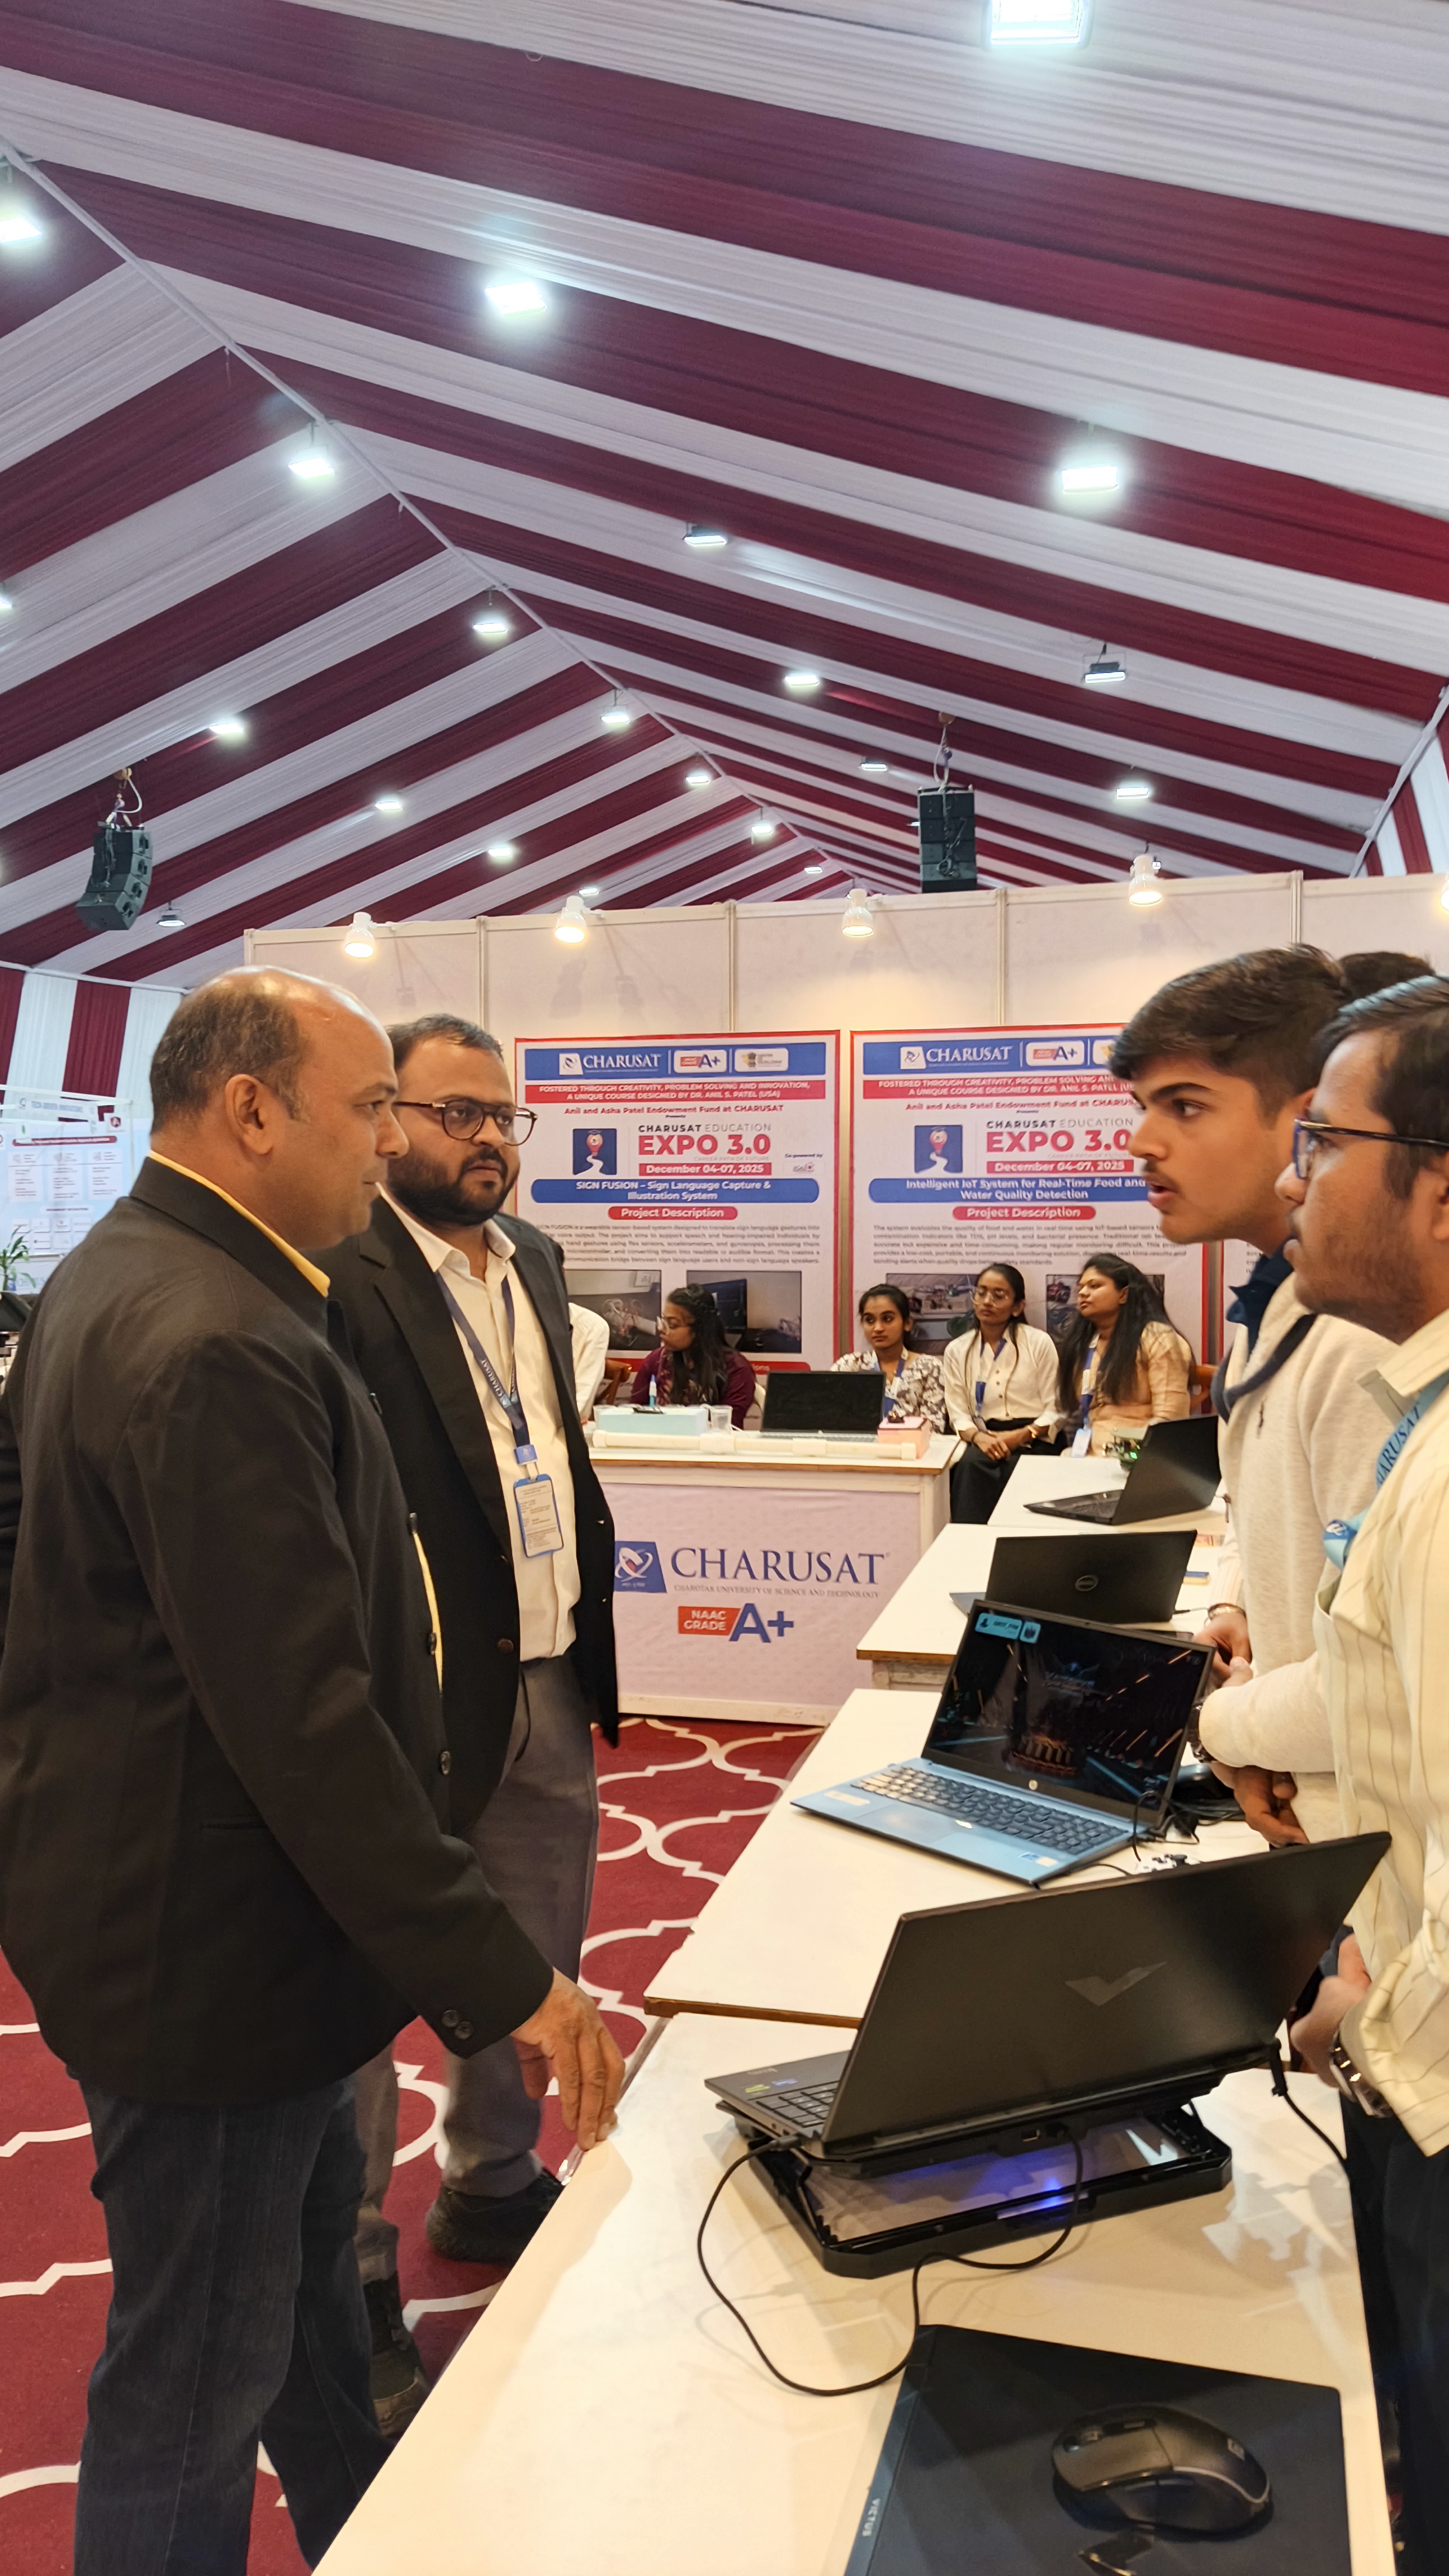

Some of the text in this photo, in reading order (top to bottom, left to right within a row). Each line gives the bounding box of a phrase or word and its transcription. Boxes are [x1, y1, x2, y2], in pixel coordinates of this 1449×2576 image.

[926, 1046, 1012, 1063] CHARUSAT
[1053, 1046, 1077, 1061] A+
[583, 1054, 661, 1068] CHARUSAT
[698, 1053, 721, 1068] A+
[964, 1078, 1014, 1087] CREATIVITY,
[759, 1090, 781, 1098] (USA)
[638, 1124, 771, 1133] CHARUSAT EDUCATION
[987, 1118, 1133, 1129] CHARUSAT EDUCATION
[638, 1134, 771, 1155] EXPO 3.0
[987, 1129, 1131, 1153] EXPO 3.0
[646, 1164, 764, 1175] December 04-07, 2025
[995, 1161, 1125, 1173] December 04-07, 2025
[576, 1181, 600, 1190] SIGN
[602, 1181, 638, 1190] FUSION
[647, 1181, 670, 1190] Sign
[671, 1181, 720, 1191] Language
[722, 1181, 761, 1190] Capture
[906, 1178, 1145, 1191] Intelligent IoT System for Real-Time Food and
[628, 1191, 718, 1201] Illustration System
[960, 1190, 1088, 1201] Water Quality Detection
[621, 1208, 724, 1219] Project Description
[967, 1208, 1081, 1219] Project Description
[671, 1546, 885, 1585] CHARUSAT
[674, 1584, 715, 1593] CHAROTAR
[716, 1585, 760, 1594] UNIVERSITY
[826, 1590, 879, 1599] TECHNOLOGY
[691, 1609, 726, 1620] NAAC
[683, 1620, 726, 1631] GRADE
[728, 1603, 794, 1643] A+
